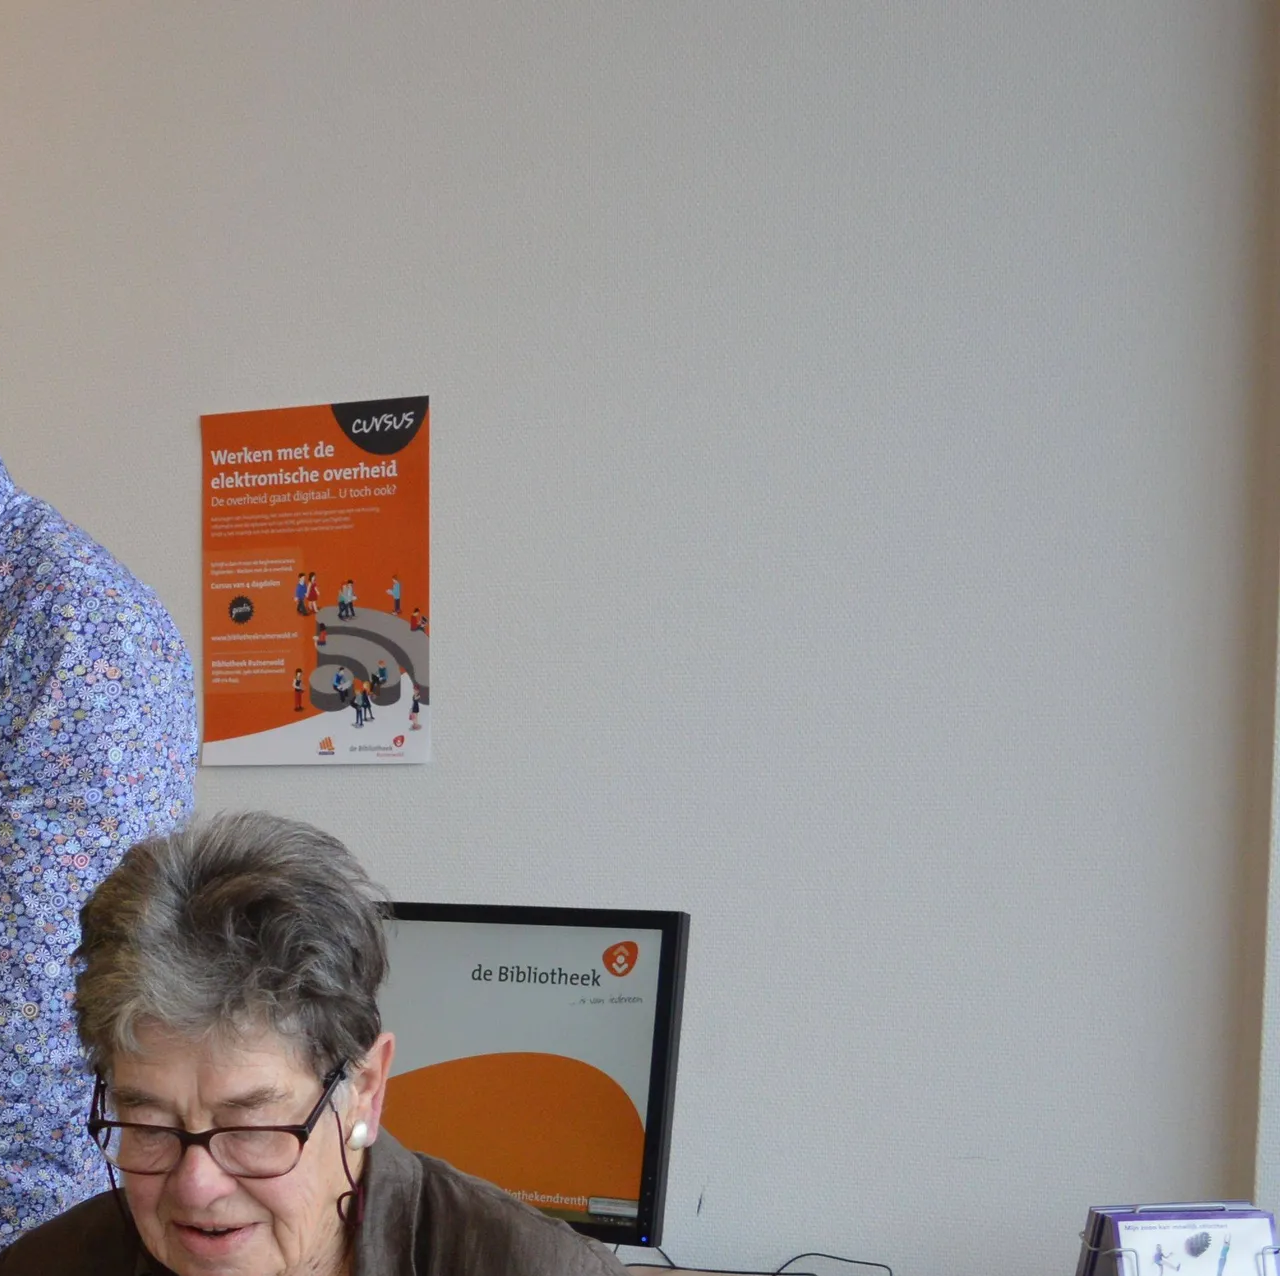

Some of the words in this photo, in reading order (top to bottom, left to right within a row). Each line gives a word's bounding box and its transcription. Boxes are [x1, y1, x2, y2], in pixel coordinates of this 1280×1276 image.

[352, 411, 414, 434] cursus
[211, 447, 273, 465] Werken
[277, 443, 310, 461] met
[314, 441, 334, 458] de
[211, 466, 319, 489] elektronische
[323, 460, 397, 482] overheid
[211, 496, 224, 507] De
[226, 492, 267, 506] overheid
[270, 491, 291, 507] gaat
[339, 488, 347, 498] U
[349, 485, 371, 498] toch
[374, 484, 397, 496] ook?
[471, 964, 493, 982] de
[498, 965, 601, 987] Bibliotheek
[503, 1188, 589, 1206] liothekendrenth
